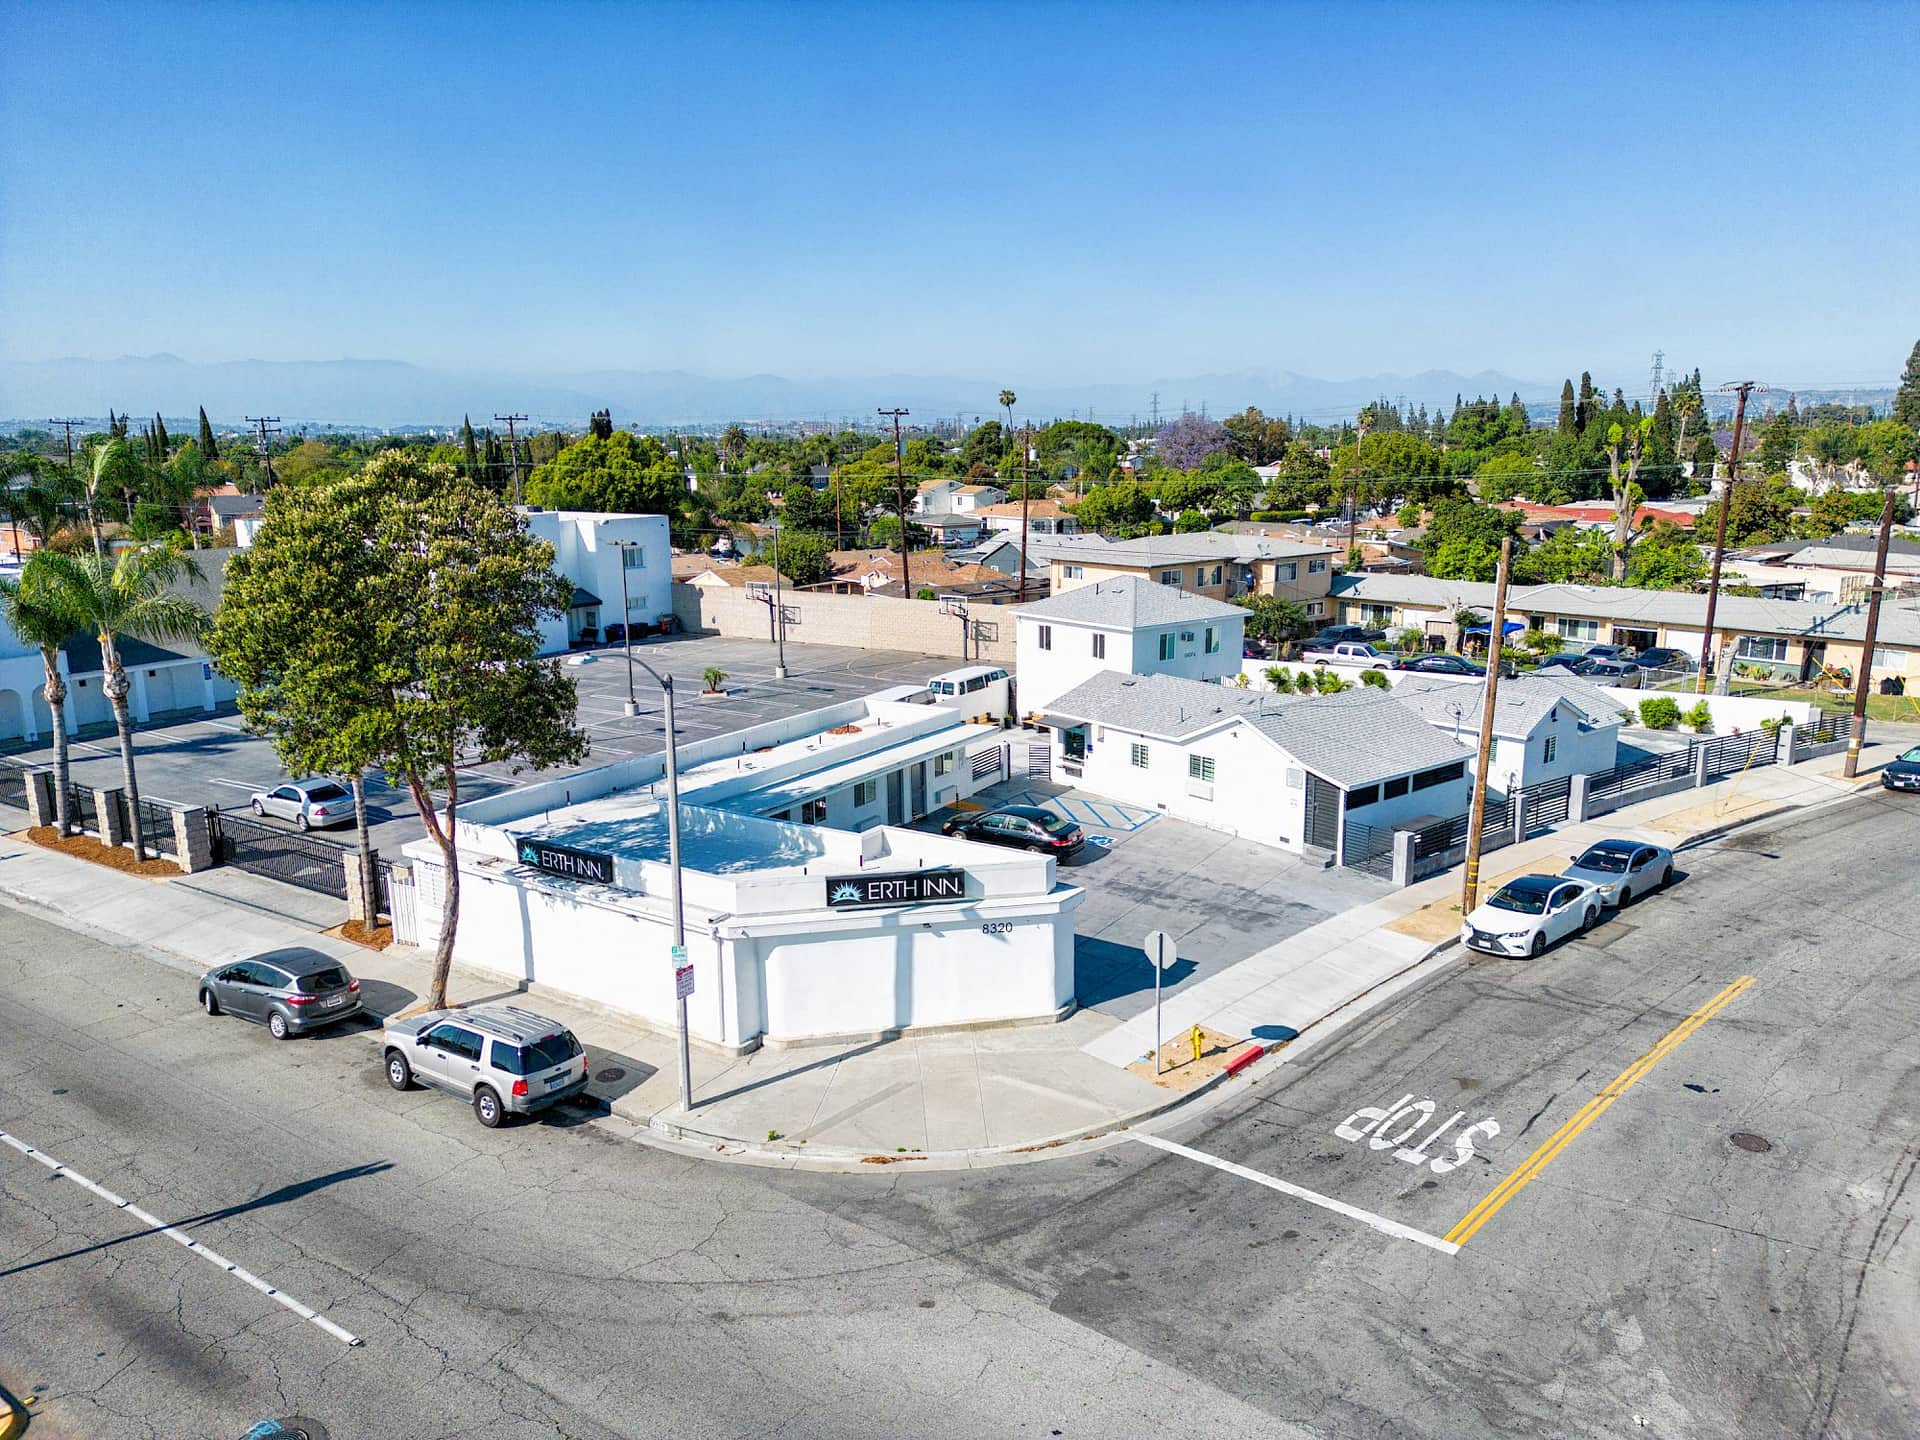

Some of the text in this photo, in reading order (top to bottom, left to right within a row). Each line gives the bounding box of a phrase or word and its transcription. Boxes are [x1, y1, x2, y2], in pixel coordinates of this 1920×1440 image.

[541, 850, 574, 872] ERTH
[868, 880, 917, 900] ERTH
[982, 922, 1013, 934] 8320
[1334, 1093, 1500, 1173] STOP
